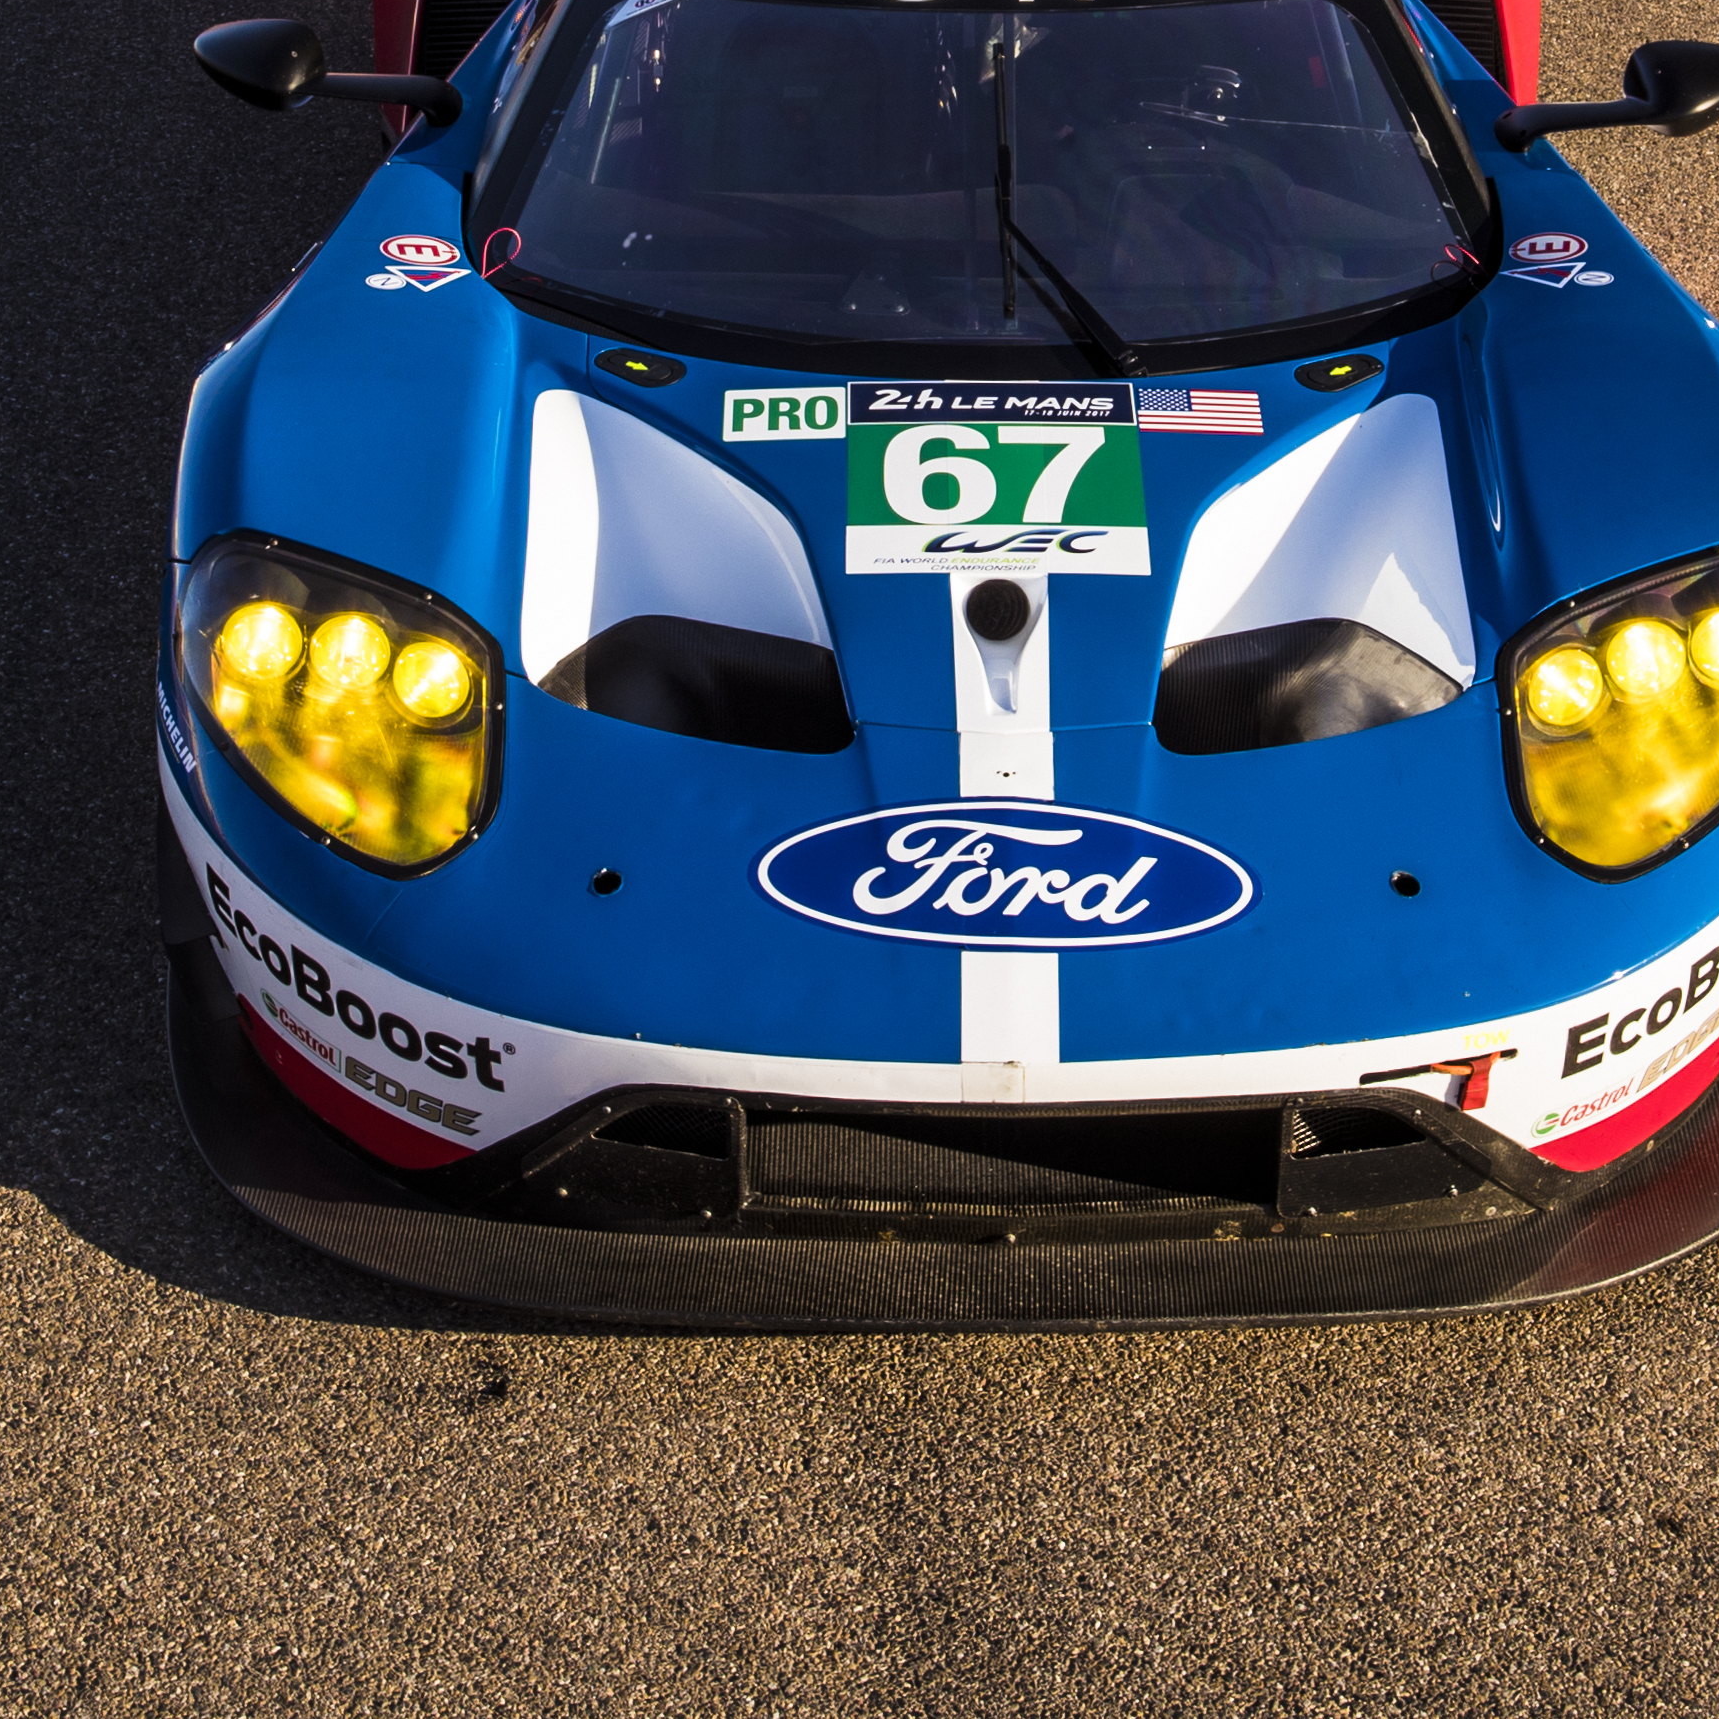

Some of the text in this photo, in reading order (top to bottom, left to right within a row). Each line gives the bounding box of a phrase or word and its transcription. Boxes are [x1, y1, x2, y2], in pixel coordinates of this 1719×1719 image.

[731, 394, 839, 433] PRO
[951, 396, 999, 410] LE
[1004, 396, 1114, 410] MANS
[1057, 409, 1081, 417] JUIN
[882, 424, 1106, 525] 67
[922, 529, 1110, 553] WEC
[873, 557, 1041, 565] FIA WORLD ENDURANCE
[157, 680, 197, 773] MICHELIN
[853, 818, 1158, 925] Ford
[1462, 1028, 1511, 1051] TOW
[278, 1006, 483, 1136] Castrol EDGE
[1560, 1077, 1635, 1127] Castrol
